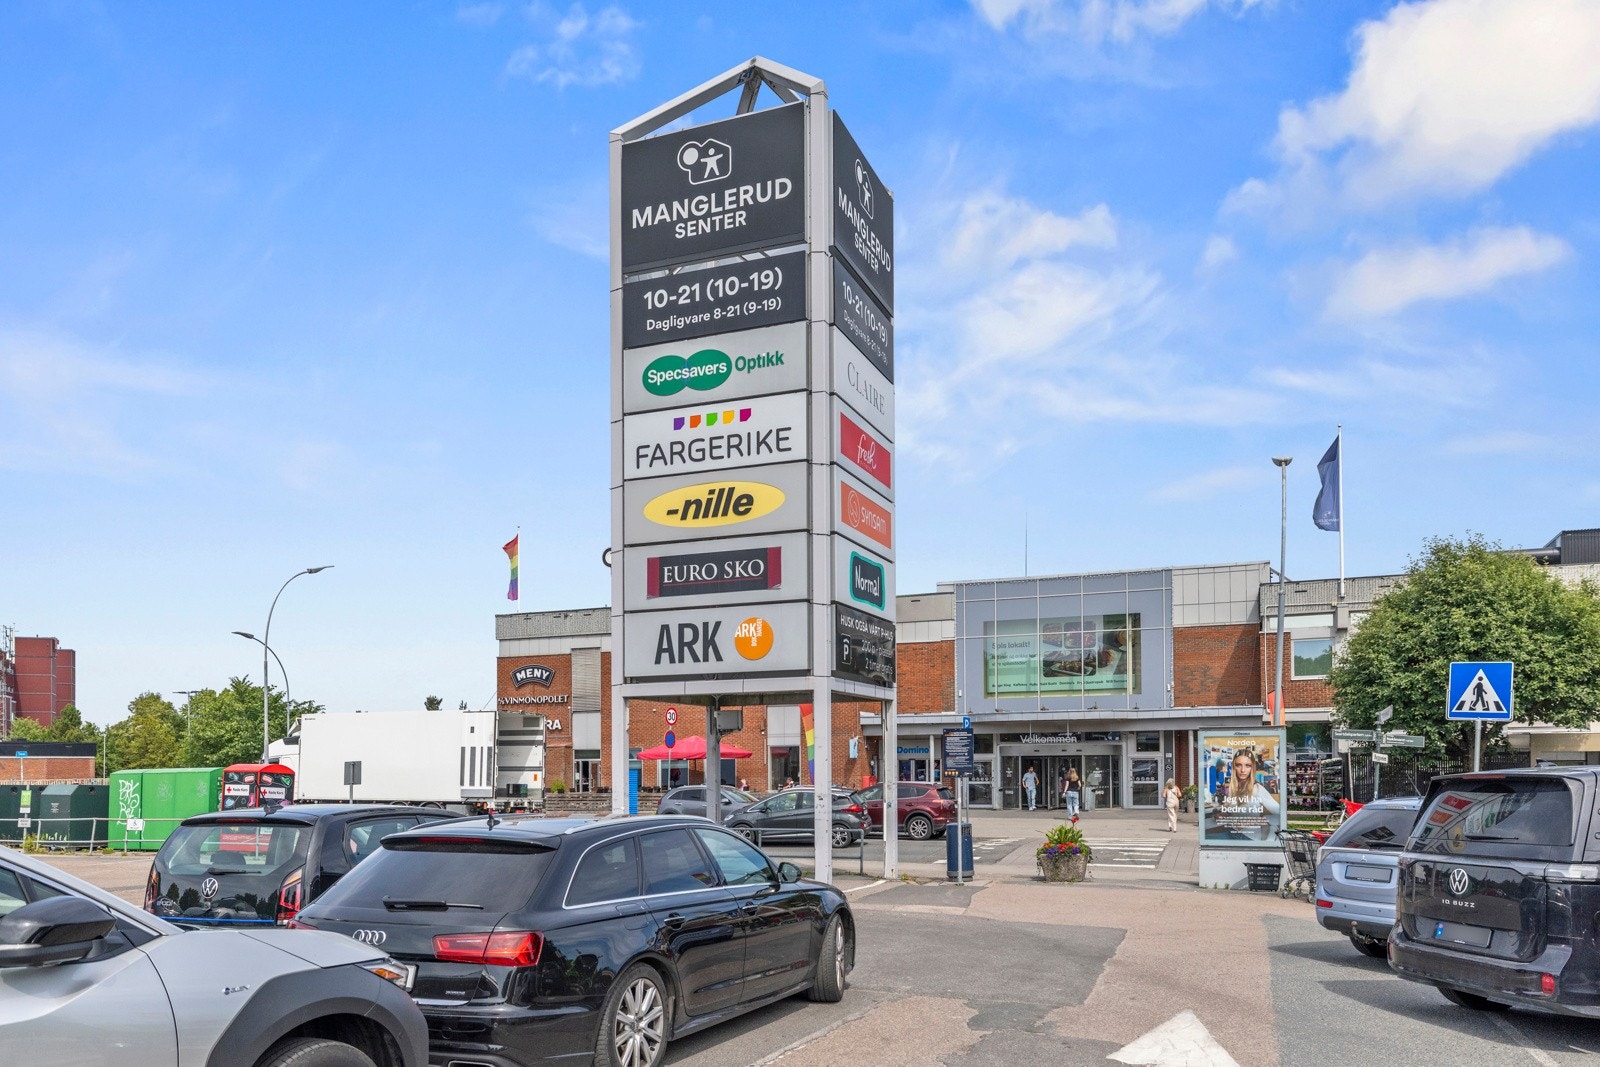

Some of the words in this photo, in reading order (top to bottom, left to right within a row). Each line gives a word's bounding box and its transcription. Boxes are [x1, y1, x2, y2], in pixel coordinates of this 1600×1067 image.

[632, 177, 792, 229] MANGLERUD
[675, 210, 747, 239] SENTER
[838, 186, 891, 272] MANGLERUD
[854, 232, 879, 274] SENTER
[643, 282, 701, 310] 10-21
[706, 266, 783, 302] (10-19)
[646, 313, 711, 331] Dagligvare
[713, 304, 741, 319] 8-21
[743, 296, 782, 316] (9-19)
[842, 281, 864, 318] 10-21
[865, 305, 888, 348] (10-19)
[647, 362, 727, 386] Specsavers
[735, 350, 784, 374] Optikk
[636, 427, 792, 469] FARGERIKE
[666, 487, 754, 521] -nille
[663, 562, 718, 583] EURO
[723, 559, 765, 579] SKO
[855, 564, 880, 597] Normal
[735, 622, 757, 638] ARK
[840, 614, 854, 629] HUSK
[654, 620, 723, 665] ARK
[516, 668, 550, 681] MENY
[504, 695, 568, 705] VINMONOPOLET
[667, 711, 676, 722] 30
[1020, 734, 1078, 744] Velkommen
[1221, 805, 1247, 813] bedre
[1248, 805, 1264, 813] råd
[1222, 796, 1237, 805] Jeg
[1452, 900, 1475, 908] BUZZ
